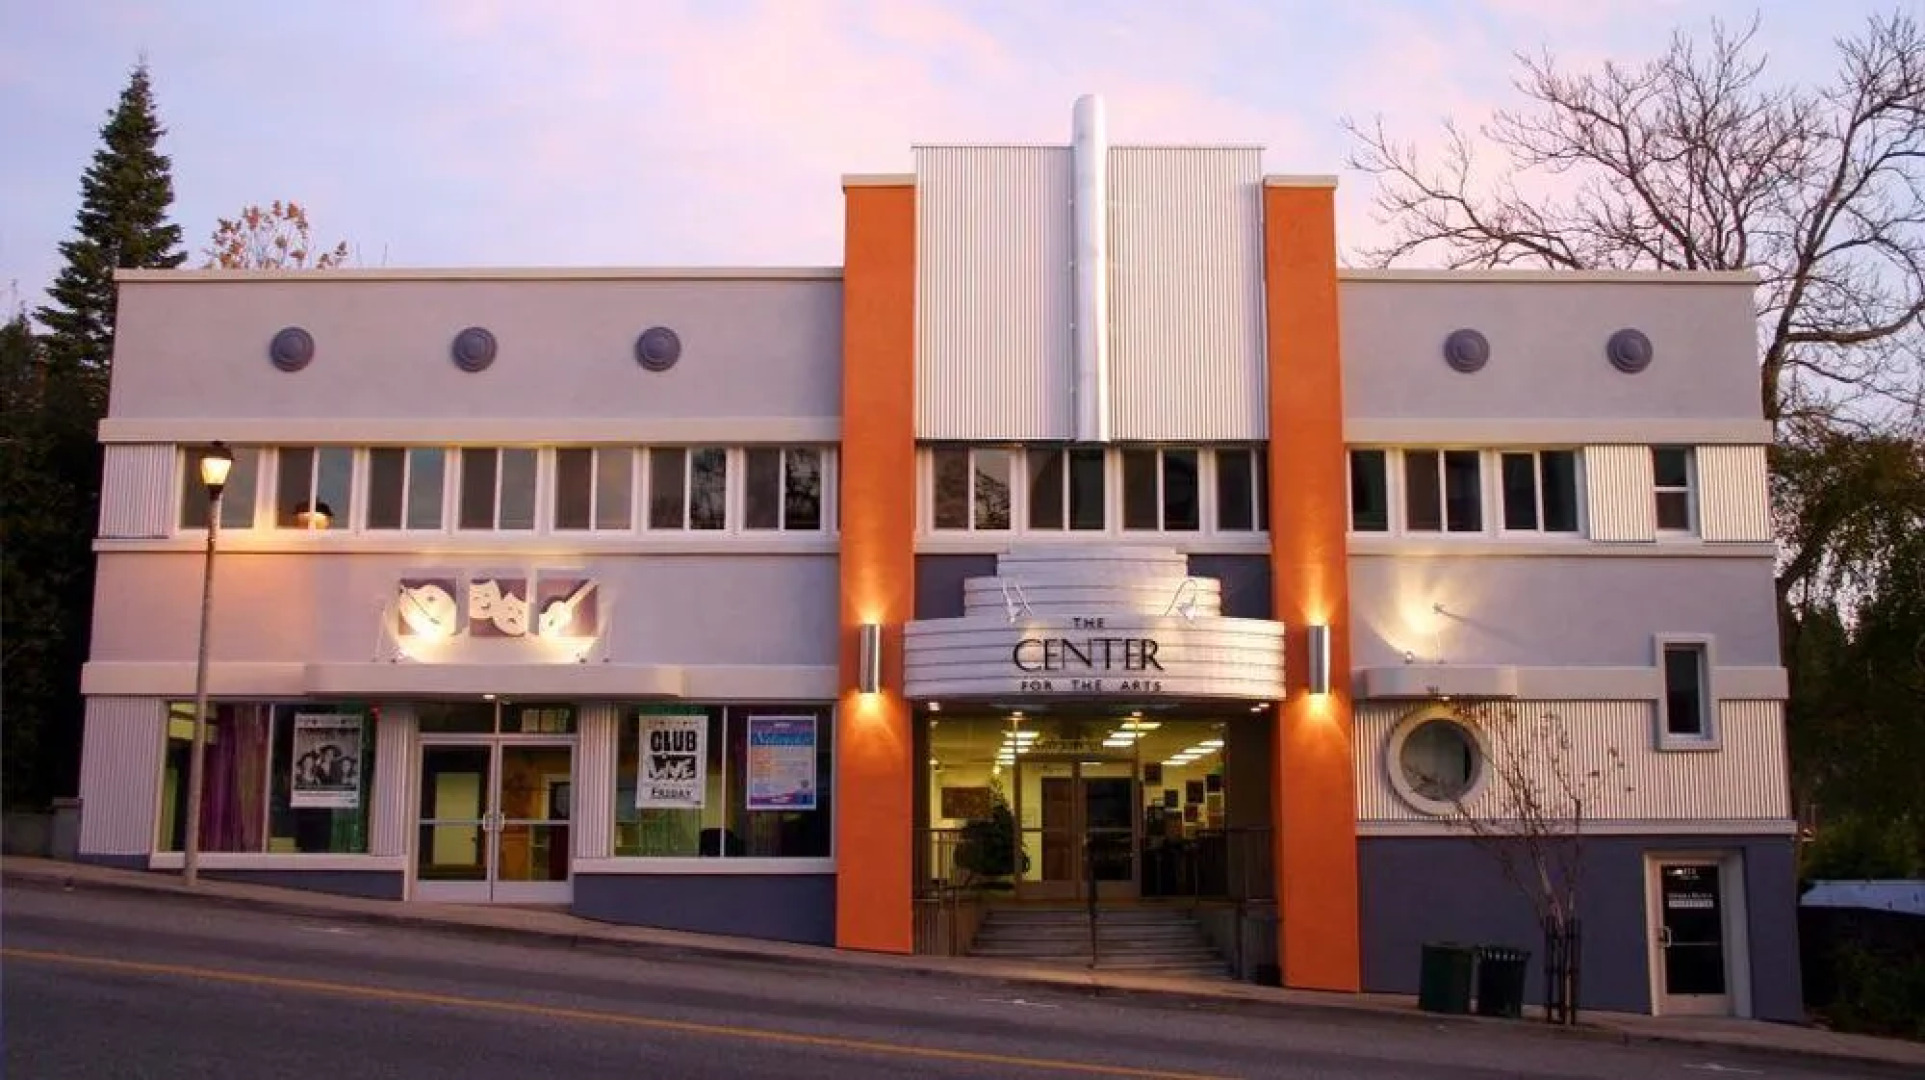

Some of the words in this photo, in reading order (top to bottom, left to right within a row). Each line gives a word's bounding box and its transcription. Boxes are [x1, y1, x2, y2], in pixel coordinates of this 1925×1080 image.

[1072, 617, 1104, 629] THE
[1013, 638, 1164, 672] CENTER
[1021, 680, 1053, 692] FOR
[1072, 680, 1103, 692] THE
[1121, 680, 1162, 692] ARTS
[650, 730, 697, 752] CLUB
